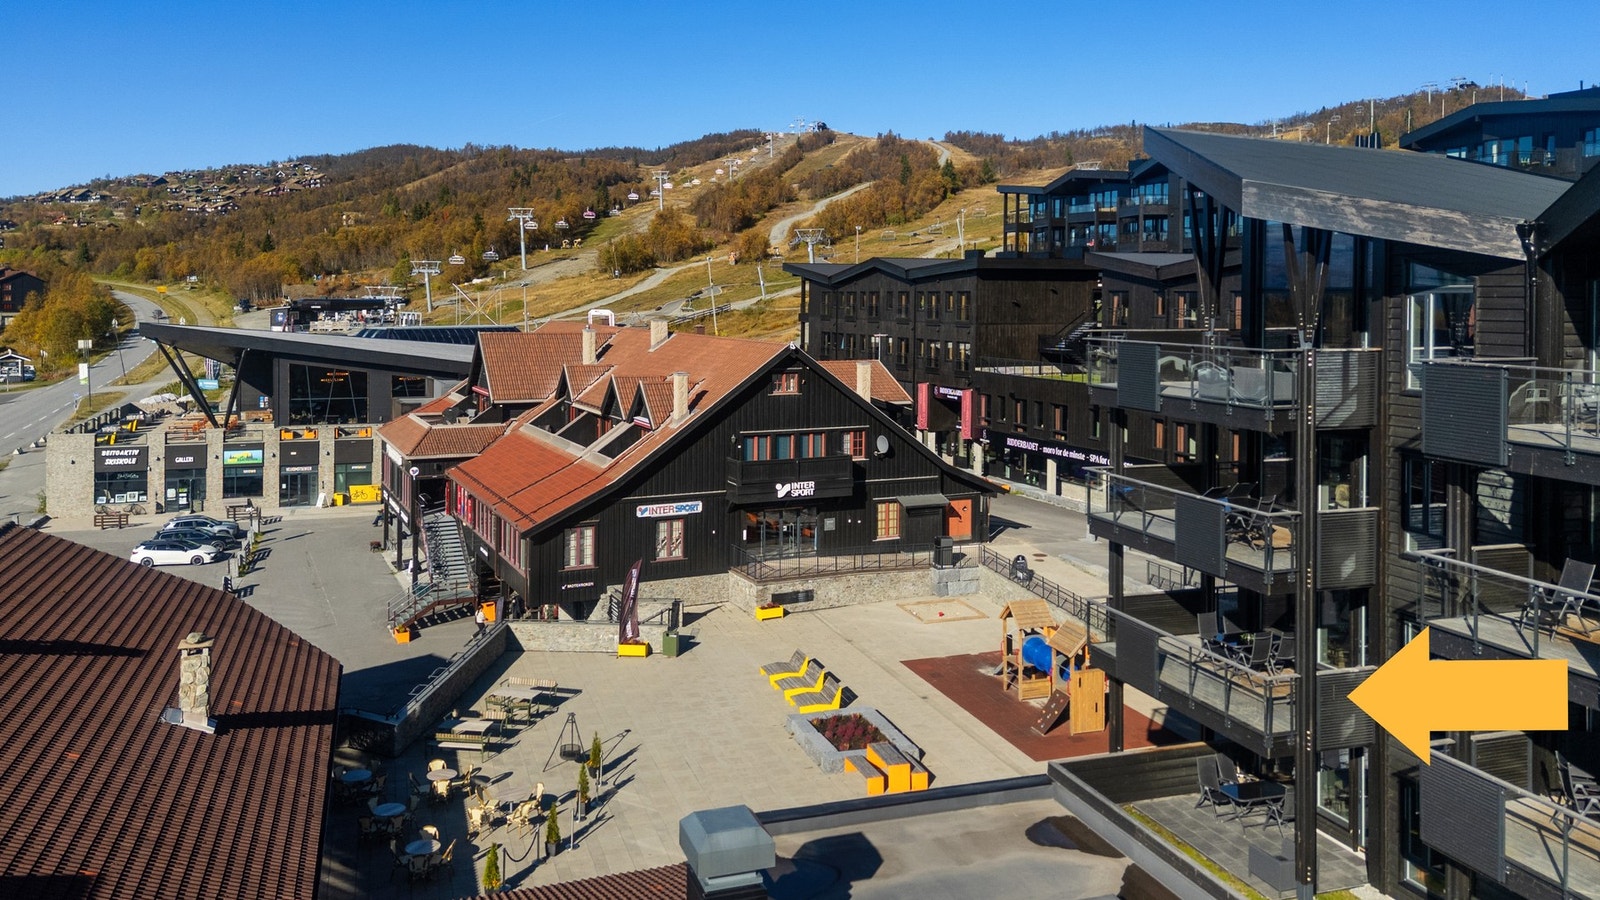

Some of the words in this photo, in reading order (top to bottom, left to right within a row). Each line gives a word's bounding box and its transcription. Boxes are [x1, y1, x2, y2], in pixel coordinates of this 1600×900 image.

[101, 449, 140, 457] BEITOAKTIV
[1006, 437, 1039, 451] RIDDERBADET
[1042, 446, 1055, 455] moro
[1055, 447, 1063, 456] for
[1063, 449, 1069, 457] de
[1069, 450, 1086, 461] minste
[1089, 453, 1100, 464] SPA
[104, 457, 137, 465] SKISKOLE
[175, 456, 194, 464] GALLERI
[791, 481, 815, 490] INTER
[791, 488, 815, 497] SPORT
